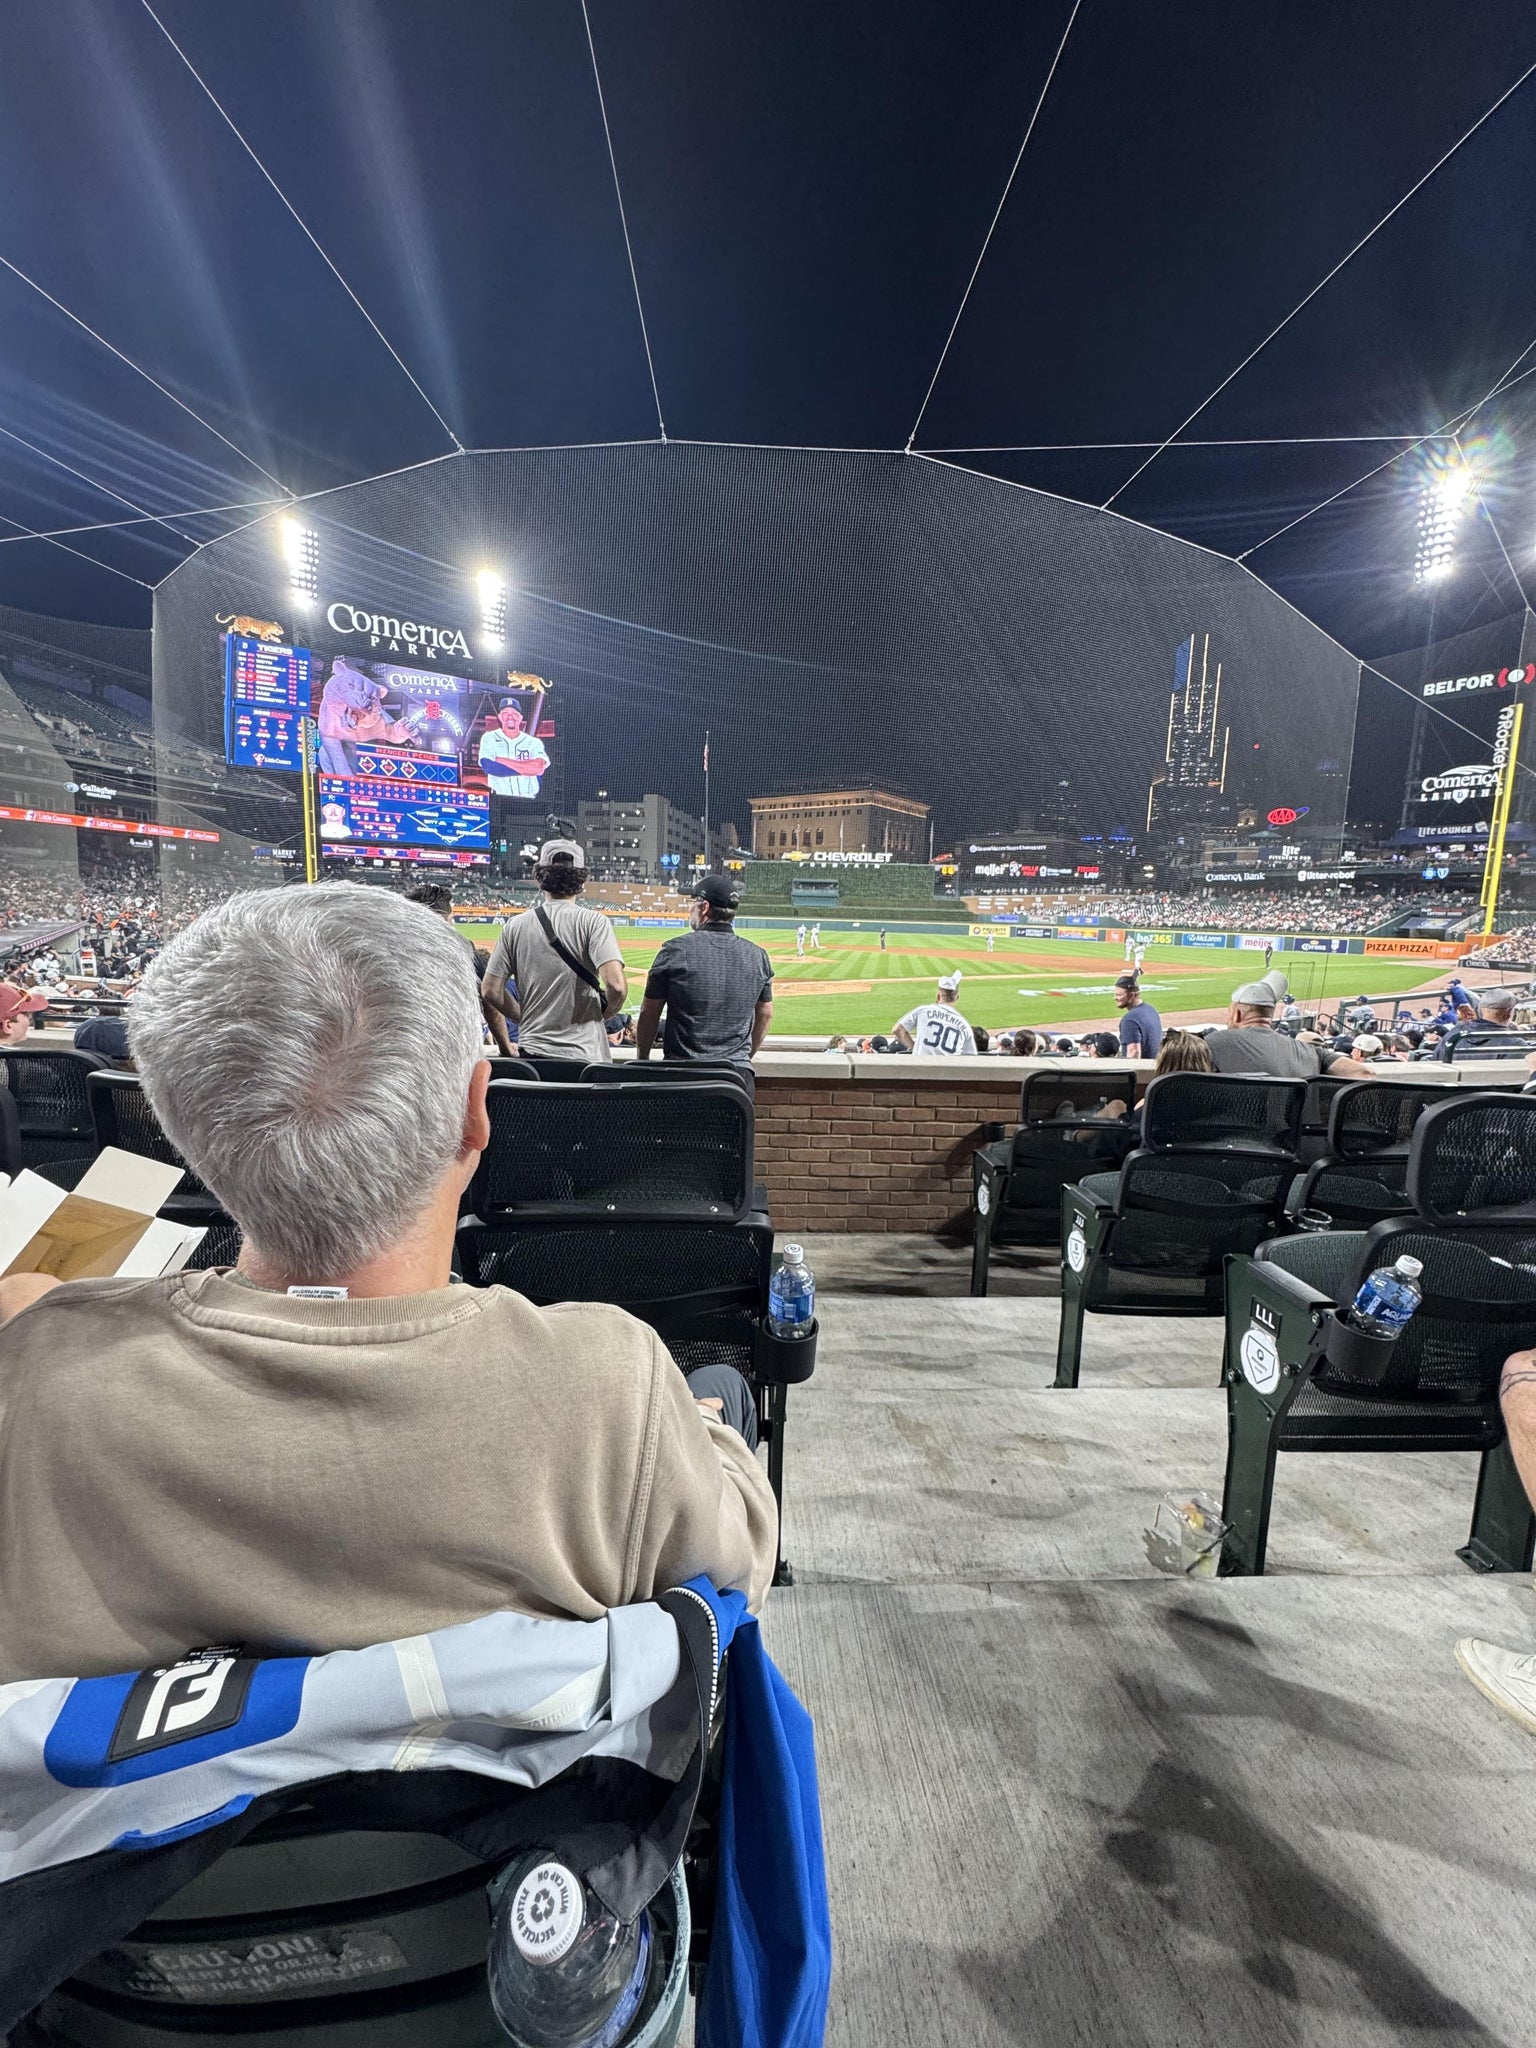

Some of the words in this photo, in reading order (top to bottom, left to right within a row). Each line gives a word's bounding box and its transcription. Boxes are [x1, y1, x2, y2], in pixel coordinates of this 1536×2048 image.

[327, 603, 473, 659] ComericA
[370, 635, 437, 658] PARK
[410, 688, 441, 696] PARK
[1423, 673, 1495, 696] BELFOR
[307, 729, 318, 772] Rocket
[1492, 719, 1514, 770] Rocket
[80, 783, 117, 796] Gallagher
[1270, 811, 1294, 823] AAA
[1437, 825, 1473, 834] LOUNGE
[814, 852, 893, 863] CHEVROLET
[975, 864, 1006, 876] meijer
[1243, 872, 1265, 881] Bank
[1136, 932, 1172, 944] bet365
[1196, 935, 1222, 943] McLaren
[1301, 943, 1326, 951] Corona
[1366, 943, 1397, 952] PIZZA!
[1399, 944, 1433, 954] PIZZA!
[926, 1010, 967, 1032] CARPENTER
[923, 1020, 961, 1054] 30
[1255, 1304, 1276, 1330] LLL
[537, 1870, 549, 1883] ON
[550, 1871, 564, 1888] CAP
[558, 1886, 569, 1914] WITH
[516, 1887, 530, 1931] BOTTLE
[521, 1925, 556, 1944] RECYCLE
